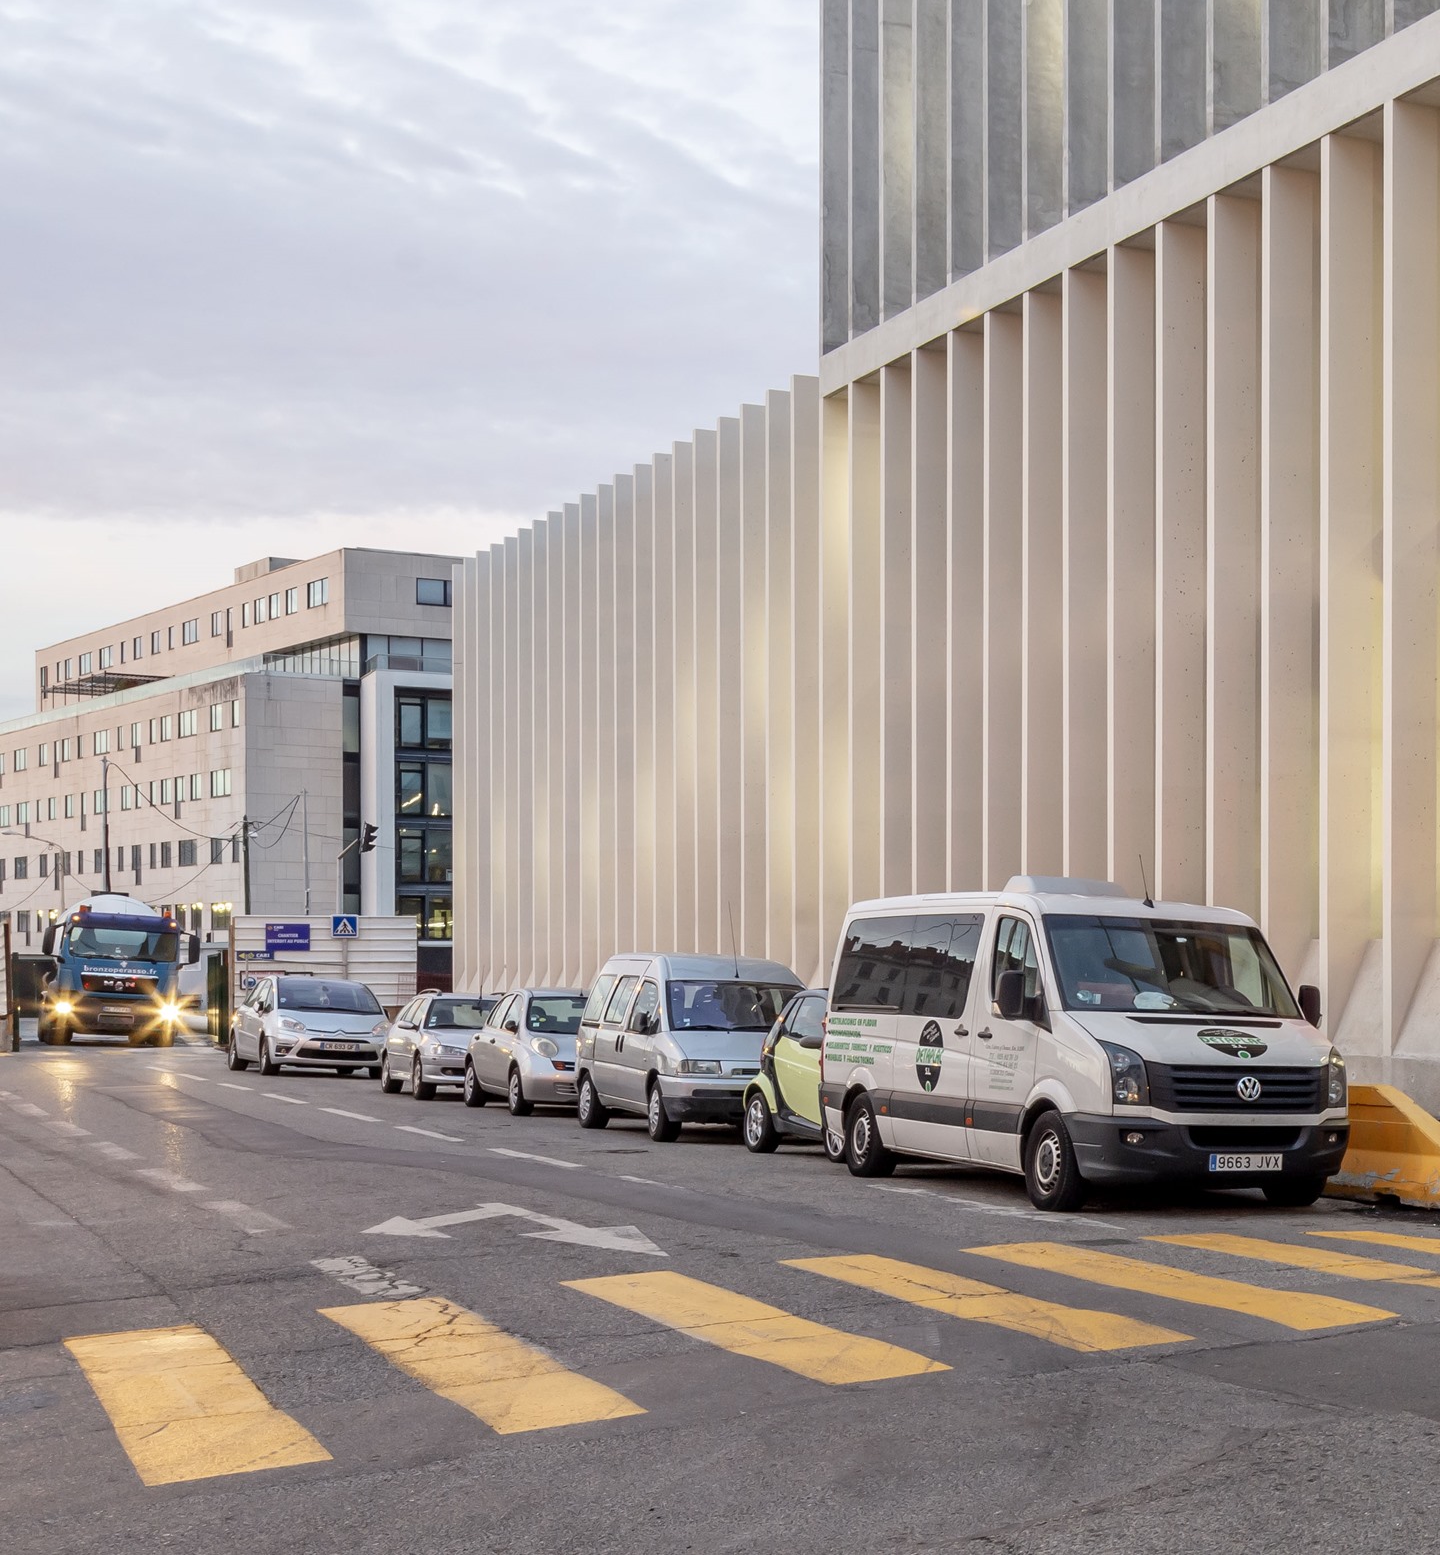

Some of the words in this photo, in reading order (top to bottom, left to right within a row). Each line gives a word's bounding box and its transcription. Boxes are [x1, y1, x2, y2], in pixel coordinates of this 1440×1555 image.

[83, 964, 157, 975] bronzoperasso.fr
[103, 980, 136, 988] MAN
[1200, 1037, 1267, 1045] DETAPLAC
[916, 1047, 944, 1065] DETAPLAC
[1218, 1156, 1251, 1169] 9663
[1257, 1155, 1280, 1169] JVX
